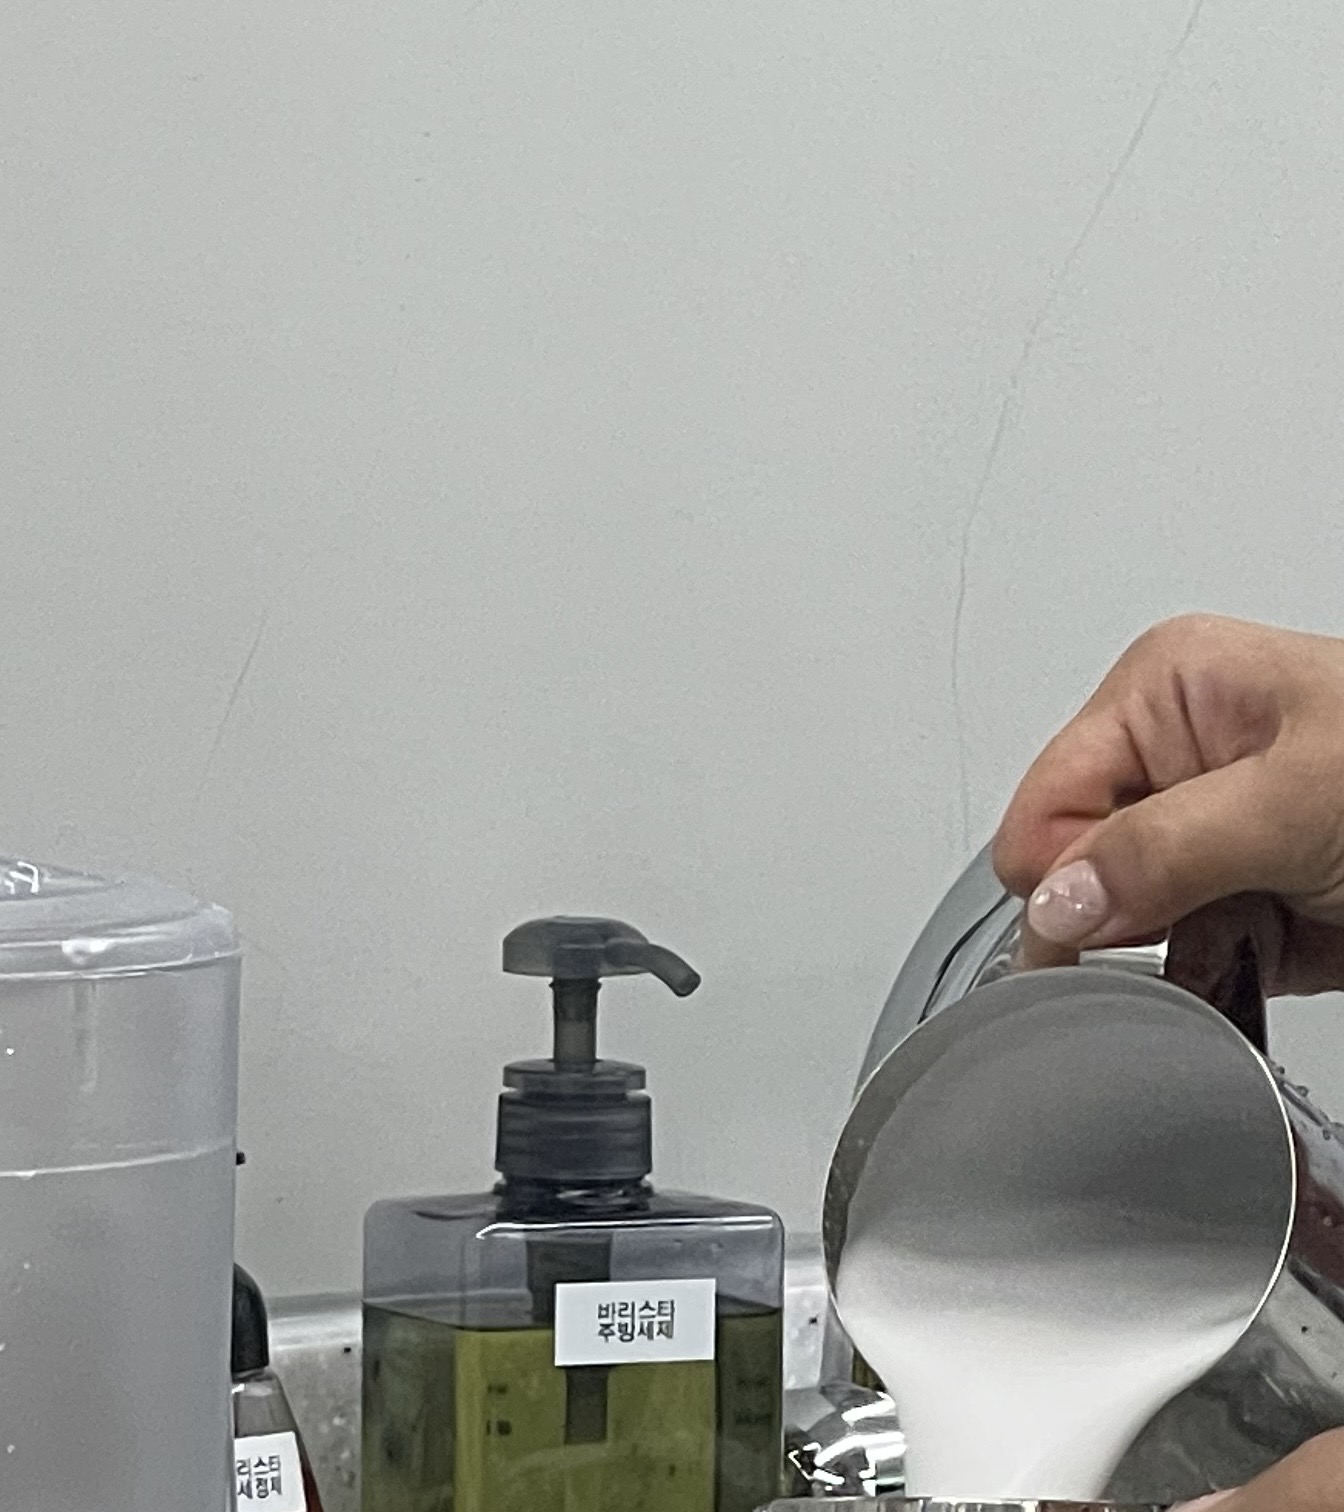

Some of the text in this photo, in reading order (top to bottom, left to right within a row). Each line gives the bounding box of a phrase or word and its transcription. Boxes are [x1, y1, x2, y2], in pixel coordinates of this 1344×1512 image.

[597, 1299, 675, 1322] 바리스타
[597, 1320, 675, 1343] 주방세제
[236, 1455, 281, 1477] 리스타
[237, 1477, 283, 1499] 세정제
